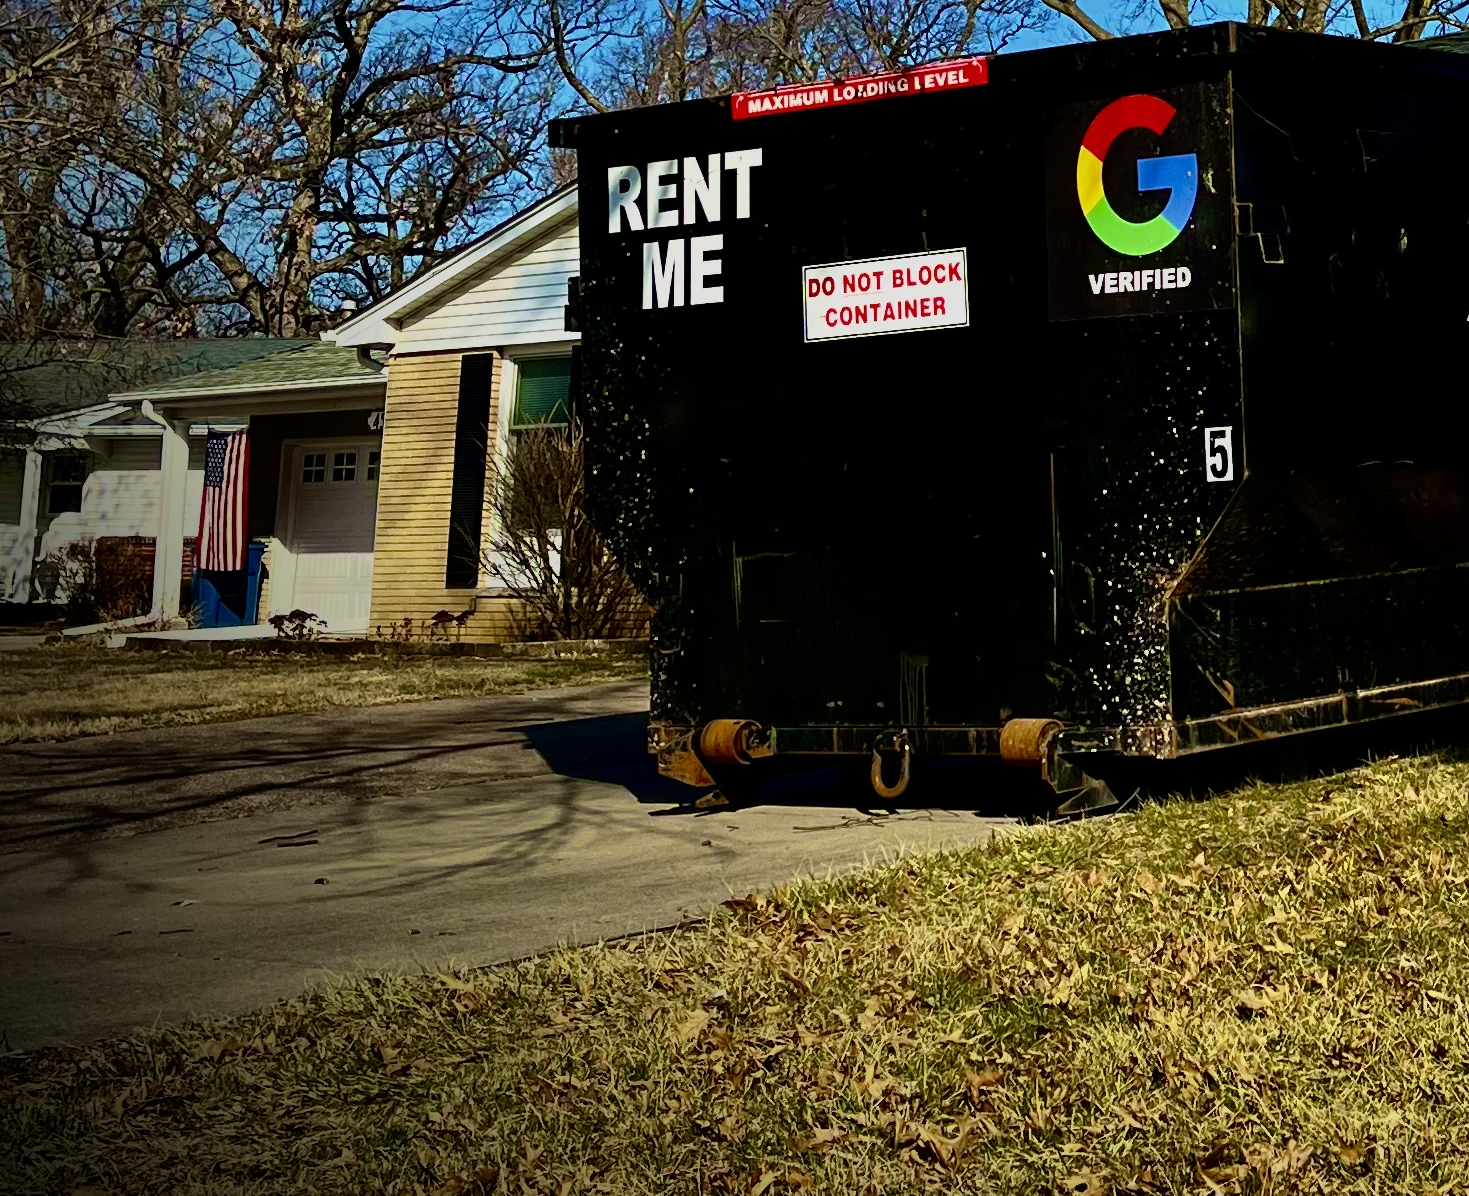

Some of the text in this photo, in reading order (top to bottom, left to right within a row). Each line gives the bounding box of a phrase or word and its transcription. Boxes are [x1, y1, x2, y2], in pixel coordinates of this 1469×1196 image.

[748, 89, 828, 114] MAXIMUM
[914, 69, 969, 90] LEVEL
[608, 148, 763, 234] RENT
[1076, 93, 1198, 256] G
[642, 234, 725, 310] ME
[808, 262, 962, 298] DO NOT BLOCK
[1088, 266, 1192, 294] VERIFIED
[825, 296, 946, 327] CONTAINER
[1209, 429, 1229, 479] 5
